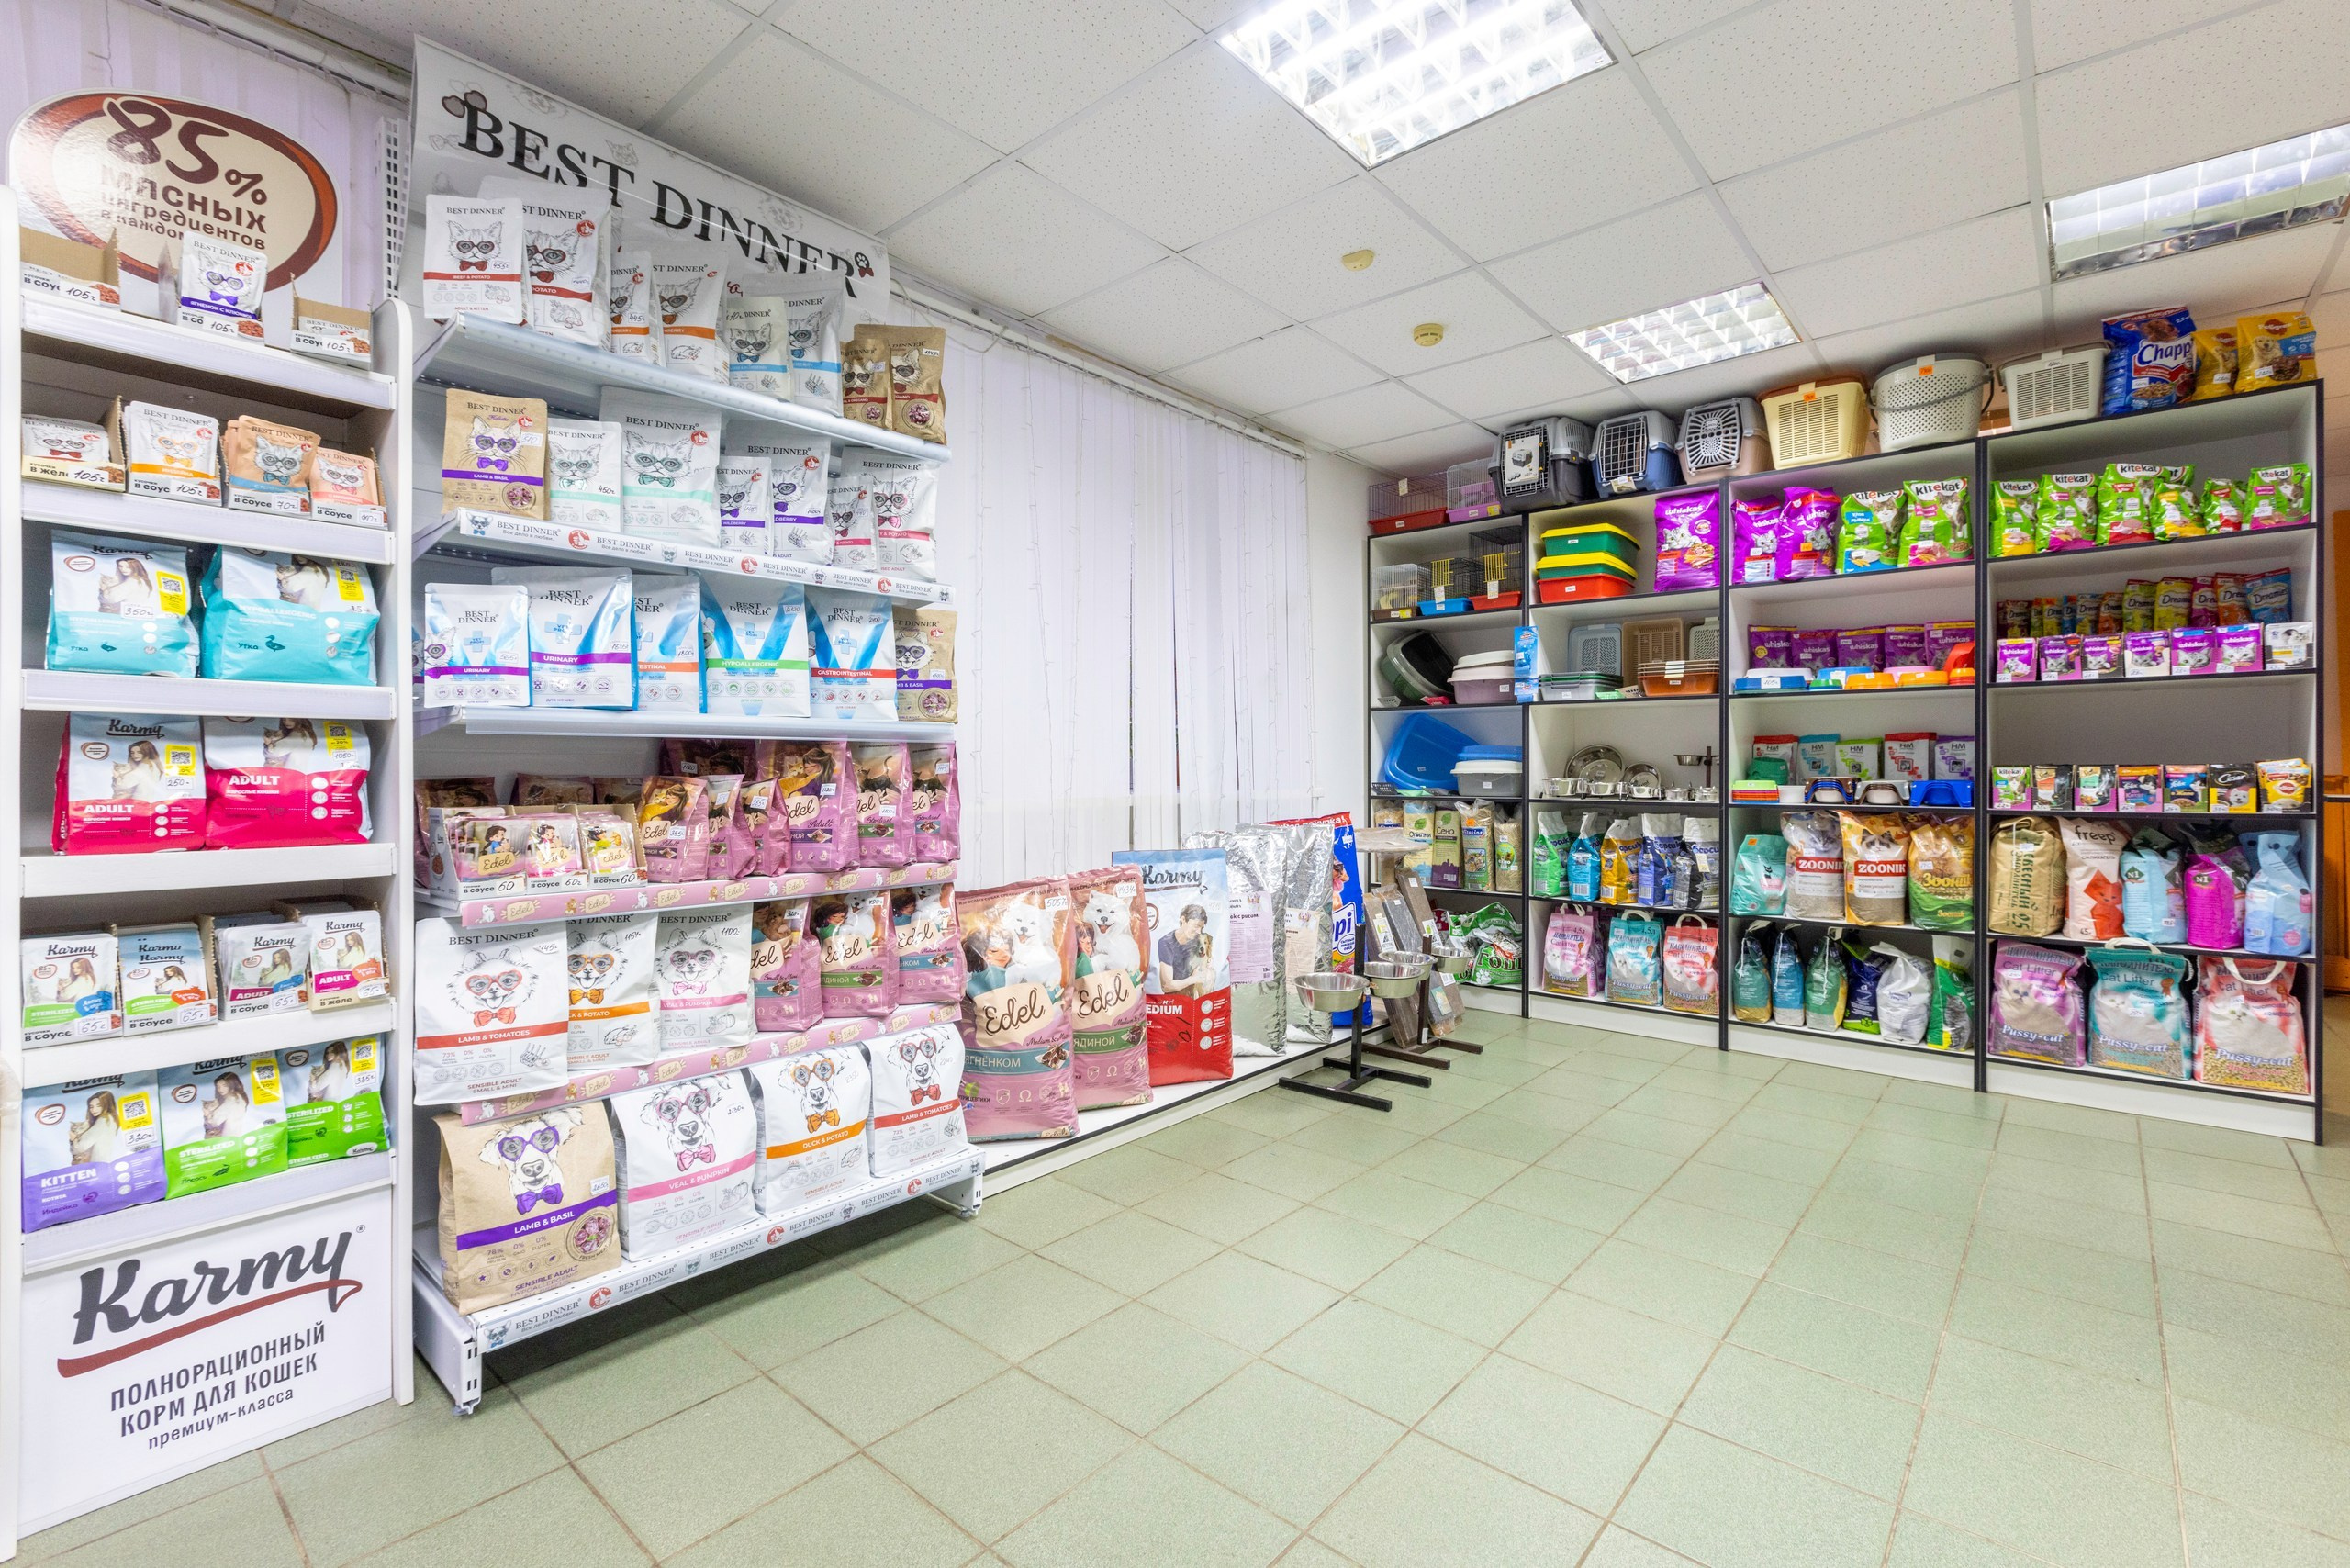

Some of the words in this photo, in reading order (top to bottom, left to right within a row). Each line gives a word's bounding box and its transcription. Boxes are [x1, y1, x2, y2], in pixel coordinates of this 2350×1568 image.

[458, 101, 635, 208] BEST
[649, 180, 858, 298] DINNER
[539, 207, 583, 220] DINNER
[2137, 340, 2192, 366] Chapp
[467, 402, 490, 412] BEST
[492, 405, 524, 415] DINNER
[626, 416, 652, 427] BEST
[655, 419, 696, 431] DINNER
[773, 446, 809, 456] DINNER
[863, 461, 887, 469] BEST
[889, 462, 919, 471] DINNER
[2121, 464, 2157, 473] kitekat
[2055, 474, 2089, 484] kitekat
[1915, 482, 1960, 496] kitekat
[2002, 482, 2033, 491] kitekat
[242, 498, 272, 508] соусе
[325, 510, 352, 519] соусе
[1665, 504, 1703, 516] whiskas
[497, 521, 520, 532] BEST
[523, 524, 559, 536] DINNER
[597, 537, 617, 546] BEST
[619, 539, 652, 551] DINNER
[239, 604, 316, 620] HYPOALLERGENIC
[736, 601, 762, 610] BEST
[107, 719, 163, 738] Karmy
[229, 776, 280, 786] ADULT
[2218, 774, 2246, 783] Cesar
[84, 804, 135, 814] ADULT
[643, 826, 668, 839] Edel
[1437, 827, 1454, 835] Сено
[484, 857, 512, 869] Edel
[1798, 859, 1843, 869] ZOONIK
[1858, 863, 1906, 873] ZOONIK
[1143, 866, 1203, 887] Karmy
[661, 891, 678, 902] Edel
[588, 898, 608, 909] Edel
[509, 905, 531, 917] Edel
[326, 921, 363, 931] Karmy
[254, 937, 295, 947] Karmy
[449, 935, 483, 946] BEST
[486, 932, 533, 944] DINNER
[48, 945, 96, 958] Karmy
[140, 955, 184, 963] Karmy
[2003, 961, 2022, 970] Cat
[2027, 964, 2056, 976] Litter
[319, 974, 351, 984] ADULT
[2098, 972, 2116, 984] Cat
[2120, 973, 2154, 986] Litter
[236, 991, 271, 999] ADULT
[1078, 973, 1129, 1018] Edel
[239, 1004, 268, 1013] соусе
[984, 986, 1046, 1036] Edel
[1146, 1004, 1182, 1014] EDIUM
[139, 1018, 173, 1027] соусе
[490, 1029, 530, 1040] TOMATOES
[2002, 1025, 2064, 1043] Pussy-cat
[2099, 1034, 2169, 1052] Pussy-cat
[2215, 1048, 2293, 1067] Pussy-cat
[661, 1063, 679, 1077] Edel
[467, 1081, 498, 1090] SENSIBLE
[499, 1077, 522, 1085] ADULT
[287, 1105, 334, 1118] STERILIZED
[901, 1113, 918, 1122] LAMB
[924, 1103, 953, 1114] TOMATOES
[802, 1140, 820, 1149] DUCK
[826, 1130, 849, 1143] POTATO
[179, 1140, 235, 1157] STERILIZED
[40, 1168, 98, 1187] KITTEN
[669, 1181, 688, 1190] VEAL
[697, 1168, 730, 1182] PUMPKIN
[514, 1222, 541, 1235] LAMB
[550, 1211, 575, 1224] BASIL
[515, 1277, 553, 1291] SENSIBLE
[554, 1265, 578, 1279] ADULT
[619, 1282, 640, 1292] BEST
[642, 1266, 675, 1285] DINNER
[73, 1232, 352, 1344] Karmy
[515, 1316, 541, 1328] BEST
[543, 1301, 580, 1322] DINNER
[110, 1321, 325, 1412] ПОЛНОРАЦИОННЫЙ
[121, 1395, 185, 1438] КОРМ
[193, 1380, 236, 1416] ДЛЯ
[245, 1353, 318, 1395] КОШЕК
[149, 1388, 294, 1450] премиум-класса
